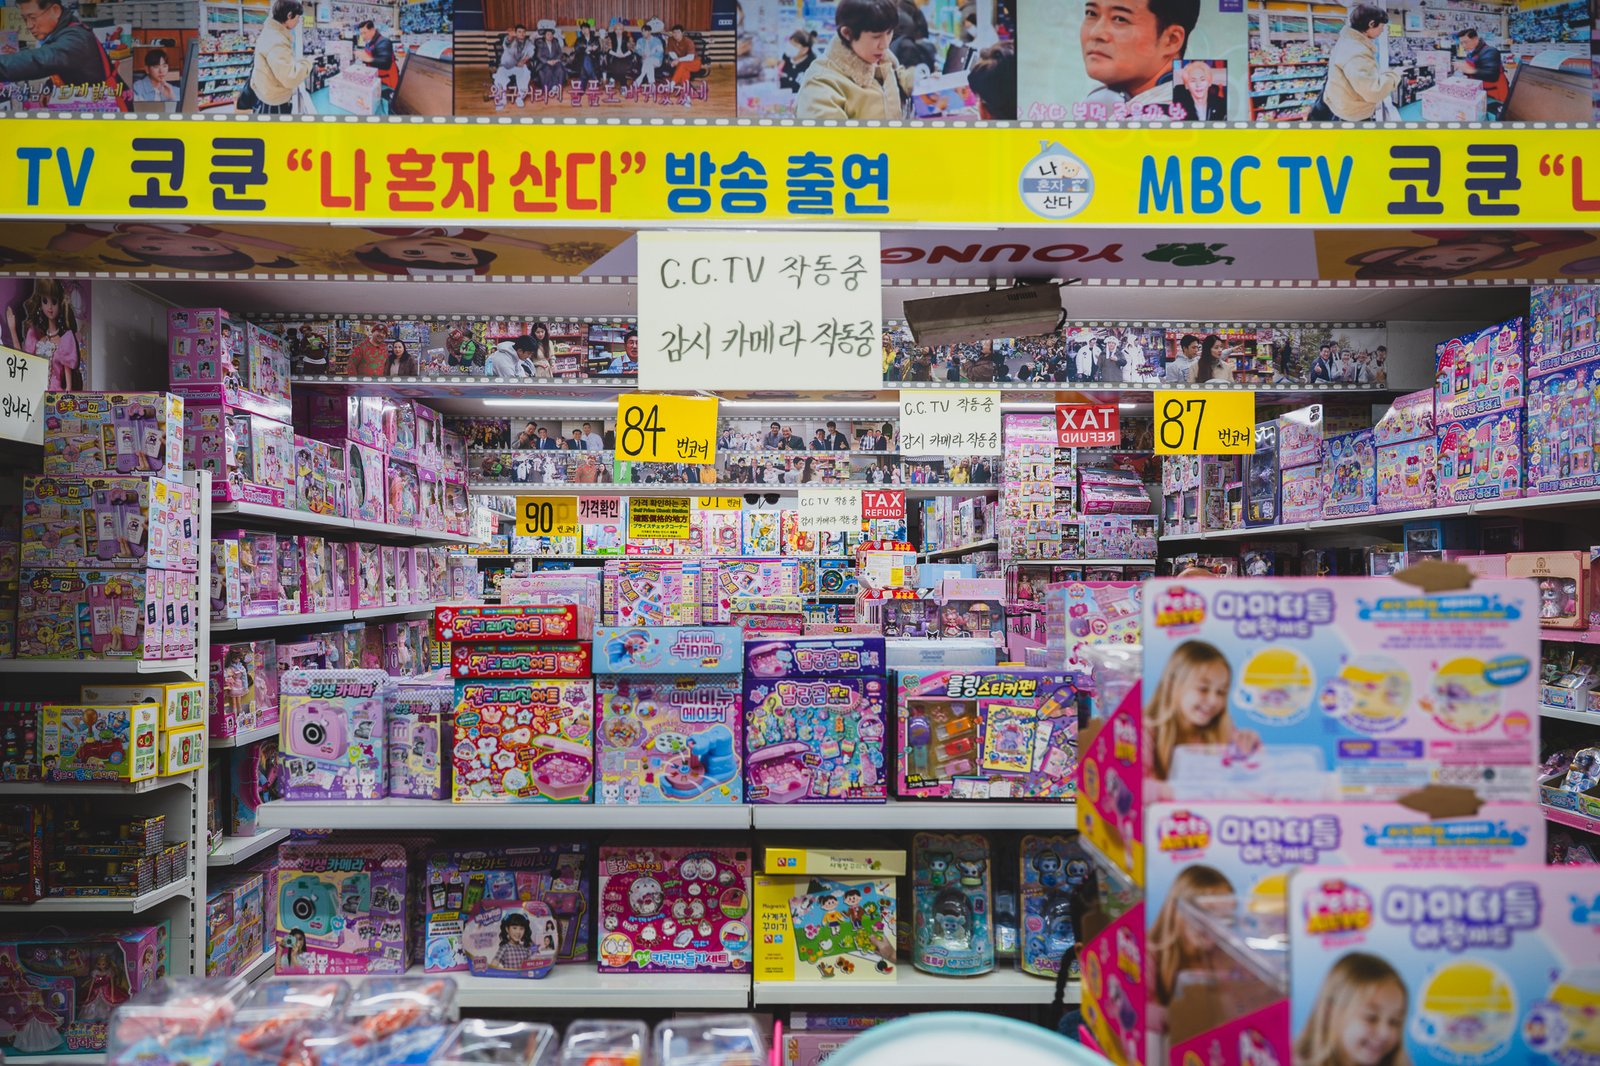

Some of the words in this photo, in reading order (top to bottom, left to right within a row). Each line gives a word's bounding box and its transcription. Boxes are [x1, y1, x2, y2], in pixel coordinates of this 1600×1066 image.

[1039, 162, 1057, 176] 나
[16, 147, 95, 206] TV
[387, 148, 495, 212] 혼자
[665, 151, 768, 214] 방송
[786, 151, 890, 215] 출연
[1036, 179, 1064, 192] 혼자
[1138, 155, 1261, 214] MBC
[1277, 155, 1353, 214] TV
[1043, 196, 1072, 209] 산다
[661, 256, 764, 289] C.C.TV
[658, 321, 710, 362] 감시
[722, 320, 806, 358] 카메라
[811, 317, 876, 358] 작동중
[6, 354, 28, 382] 입구
[622, 404, 666, 457] 84
[1160, 399, 1206, 450] 87
[902, 433, 924, 450] 감시
[930, 432, 964, 448] 카메라
[580, 499, 619, 518] 가격확인
[864, 493, 902, 508] TAX
[525, 502, 553, 533] 90
[865, 508, 902, 517] REFUND
[309, 683, 375, 698] 인생카메라
[947, 674, 981, 698] 롤링
[977, 679, 1037, 698] 스티커펜
[762, 912, 788, 923] 사계절
